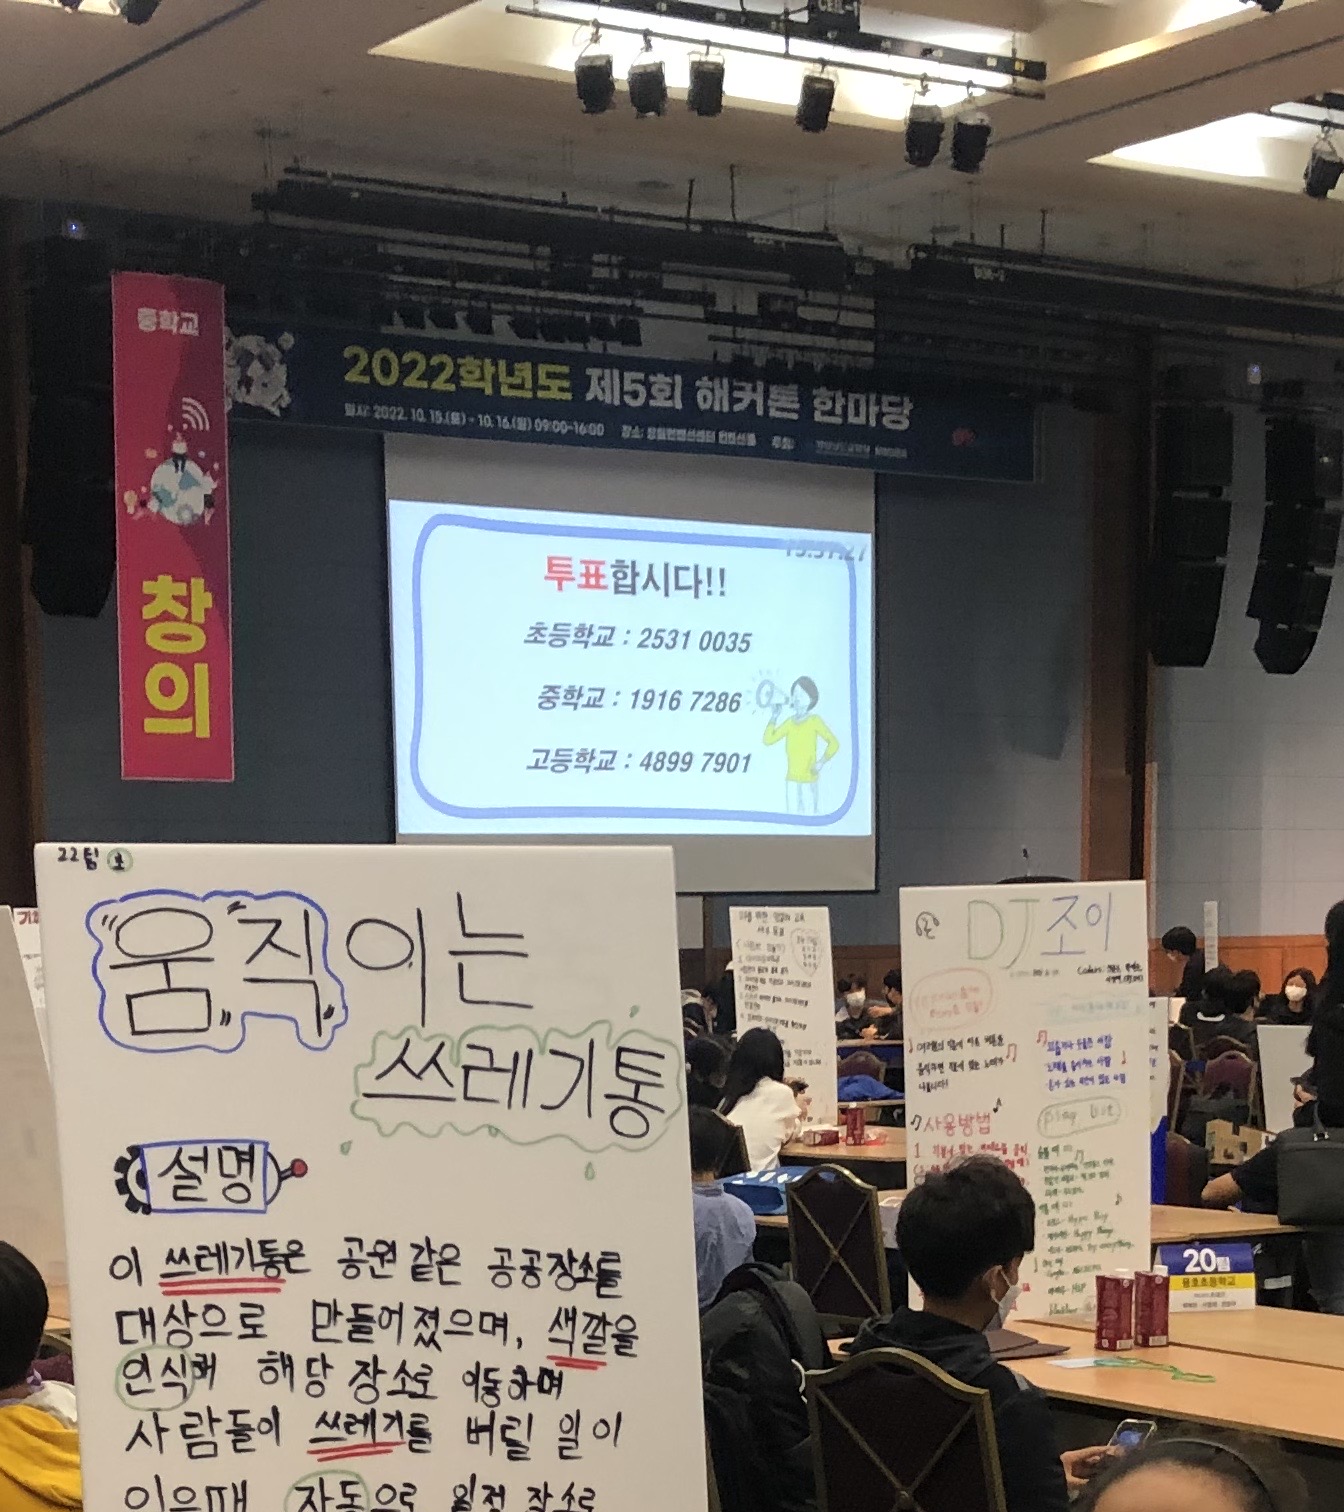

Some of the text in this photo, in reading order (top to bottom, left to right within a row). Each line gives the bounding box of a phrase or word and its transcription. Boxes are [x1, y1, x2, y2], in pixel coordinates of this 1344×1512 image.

[137, 307, 199, 337] 중학교
[343, 345, 914, 431] 2022학년도 제5회 해커톤 한마당
[373, 406, 407, 420] 2022.
[411, 408, 426, 422] 10.
[477, 414, 493, 428] 10.
[544, 555, 727, 600] 투표합시다!!
[142, 574, 213, 738] 창의
[524, 622, 616, 649] 초등학교
[637, 627, 689, 650] 2531
[698, 630, 753, 653] 0035
[537, 684, 606, 710] 중학교
[630, 688, 682, 711] 1916
[689, 691, 743, 713] 7286
[526, 747, 618, 774] 고등학교
[639, 750, 694, 773] 4899
[700, 752, 753, 774] 7901
[361, 1038, 666, 1140] 쓰레기통
[923, 1111, 991, 1138] 사용방법
[158, 1143, 256, 1205] 설명
[109, 1235, 623, 1299] 이 쓰레기통은 공원 같은 공공장소를
[115, 1299, 268, 1349] 대상으로
[548, 1305, 639, 1358] 색깔을
[257, 1350, 335, 1398] 해당
[347, 1353, 438, 1405] 장소로
[462, 1360, 564, 1408] 이동하며
[125, 1405, 281, 1460] 사람들이
[308, 1411, 433, 1456] 쓰레기를
[466, 1413, 534, 1461] 버릴
